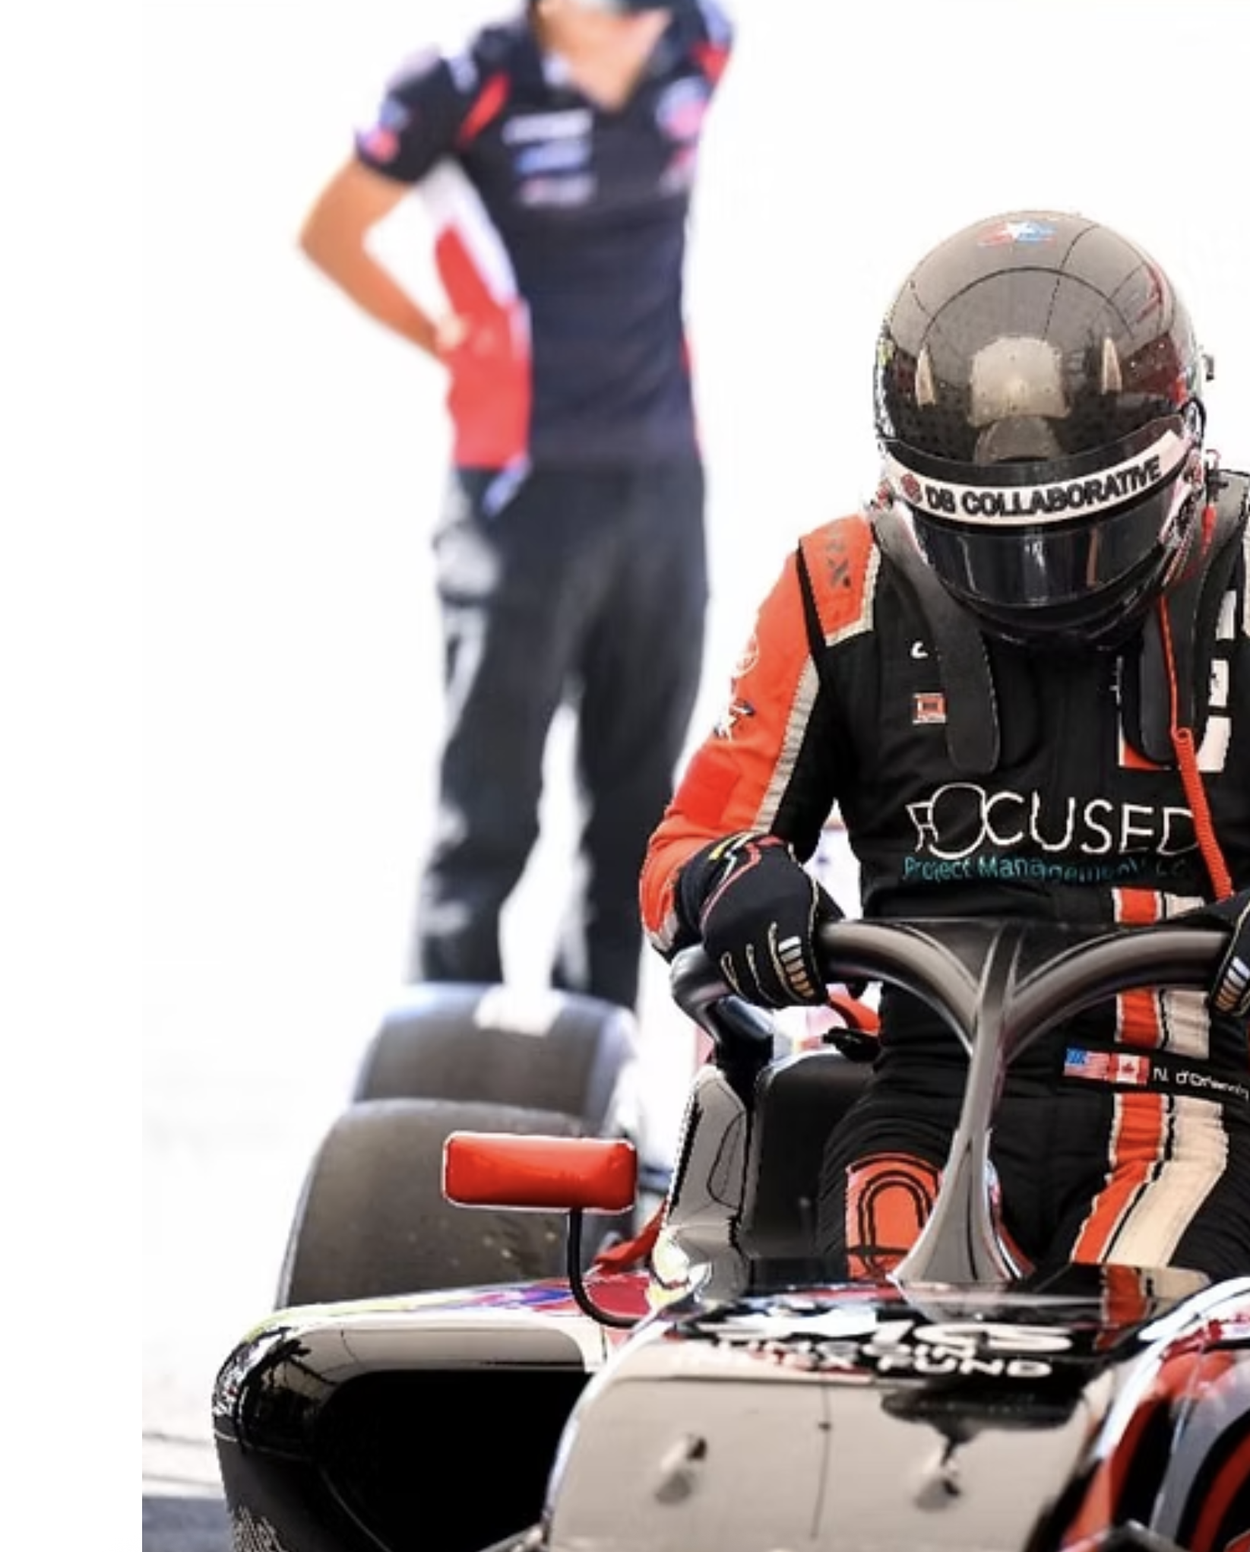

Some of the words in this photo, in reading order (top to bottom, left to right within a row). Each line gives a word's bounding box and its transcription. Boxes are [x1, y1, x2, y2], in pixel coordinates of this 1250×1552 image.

[925, 485, 956, 514] DB
[962, 456, 1160, 516] COLLABORATIVE
[905, 782, 1200, 860] FOCUSED
[902, 855, 971, 882] Project
